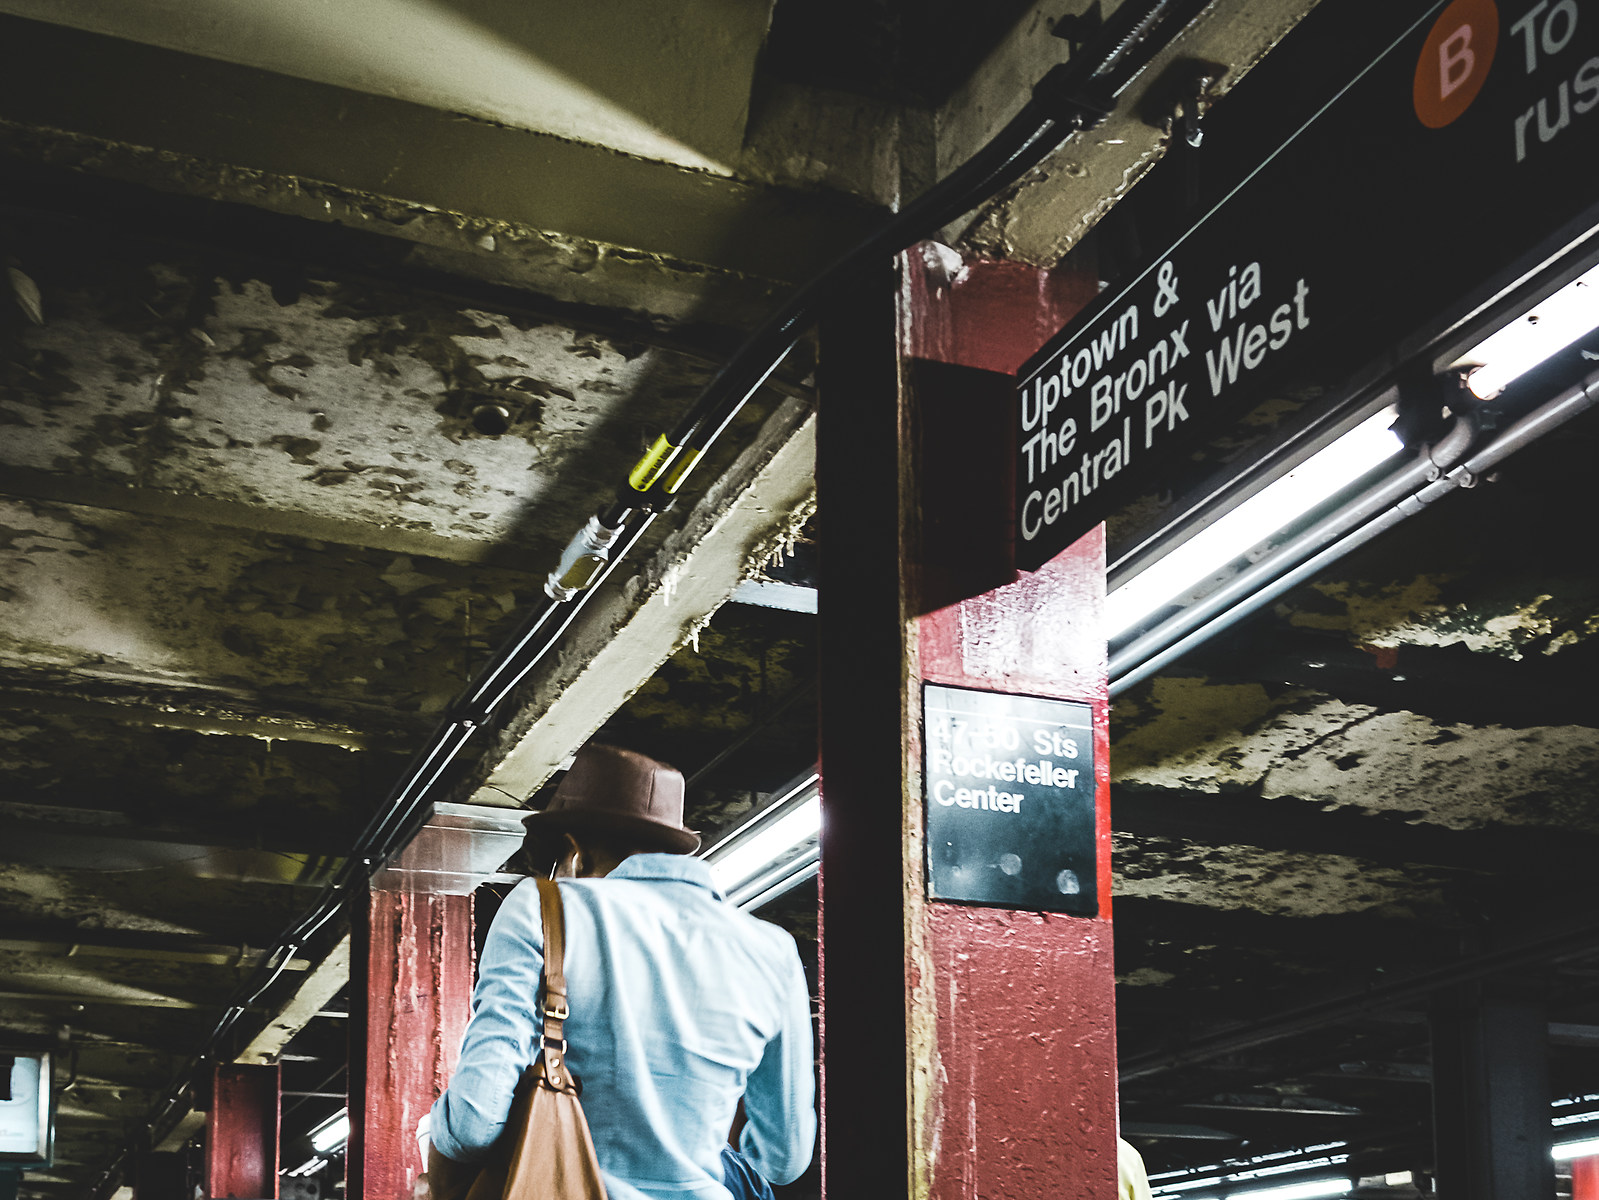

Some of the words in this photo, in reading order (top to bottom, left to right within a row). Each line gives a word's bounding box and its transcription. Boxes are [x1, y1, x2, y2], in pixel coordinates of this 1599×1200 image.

[1438, 23, 1475, 100] B
[1510, 0, 1579, 75] To
[1021, 304, 1139, 432] Uptown
[1153, 260, 1180, 318] &
[1021, 417, 1078, 484] The
[1090, 319, 1191, 433] Bronx
[1206, 261, 1262, 333] via
[1020, 416, 1132, 541] Central
[1145, 379, 1190, 450] Pk
[1205, 278, 1310, 397] West
[931, 748, 1080, 790] Rockefeller
[1033, 728, 1079, 760] Sts
[933, 779, 1025, 814] Center
